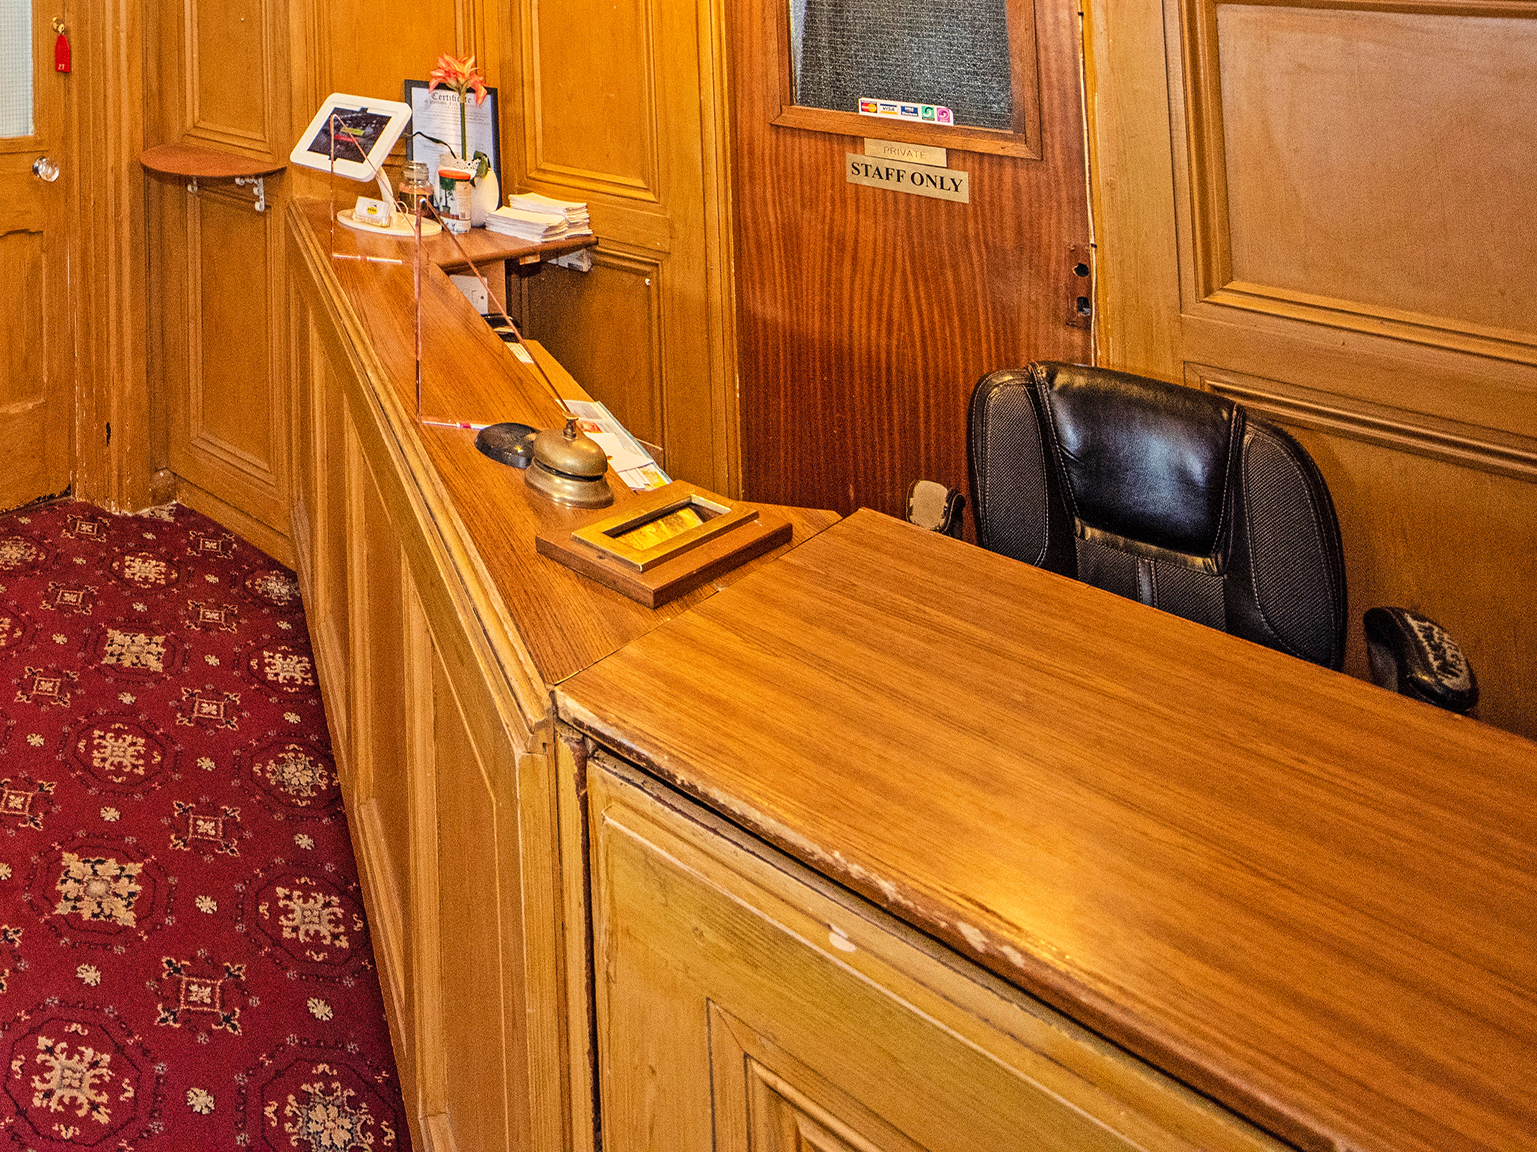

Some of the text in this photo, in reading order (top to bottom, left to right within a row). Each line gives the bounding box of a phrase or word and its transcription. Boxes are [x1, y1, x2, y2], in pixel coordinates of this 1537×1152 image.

[431, 91, 472, 103] Certifice
[883, 146, 927, 160] PRIVATE
[851, 161, 963, 193] STAFF ONLY
